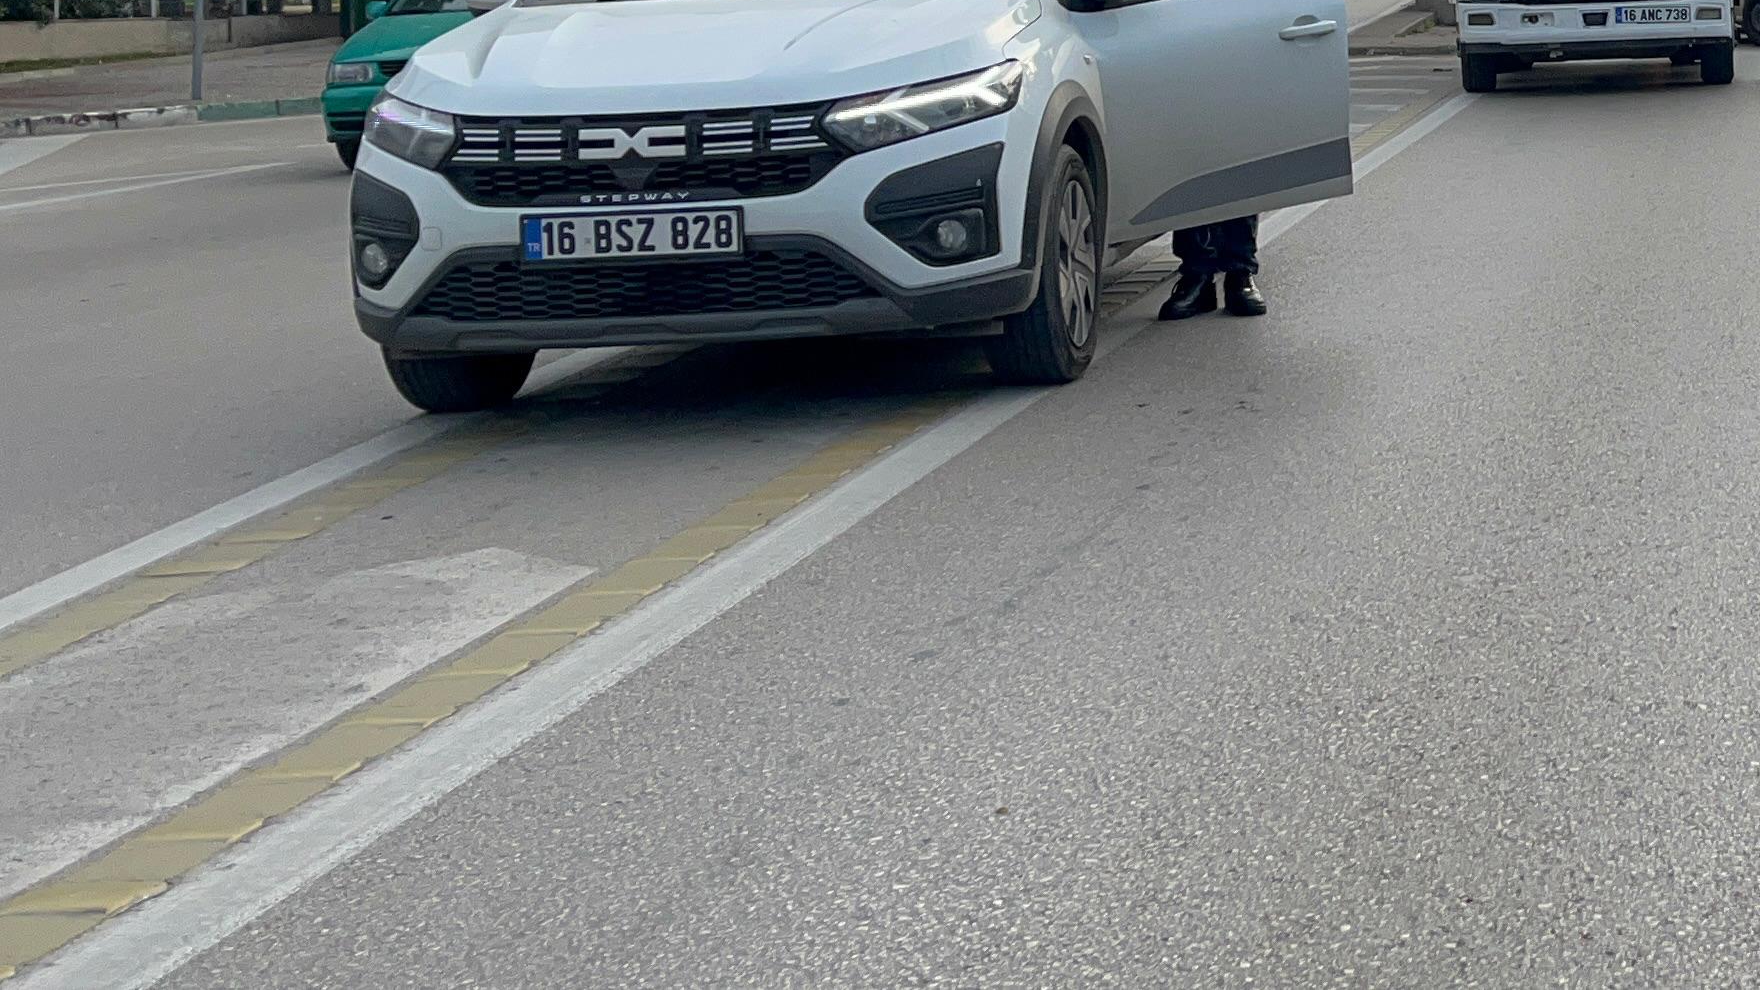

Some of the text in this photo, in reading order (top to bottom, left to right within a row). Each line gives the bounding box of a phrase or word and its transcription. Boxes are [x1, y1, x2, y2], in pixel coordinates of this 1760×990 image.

[1624, 8, 1688, 21] 16 ANC 738
[579, 191, 690, 204] STEPWAY
[527, 214, 733, 256] TR 16 BSZ 828
